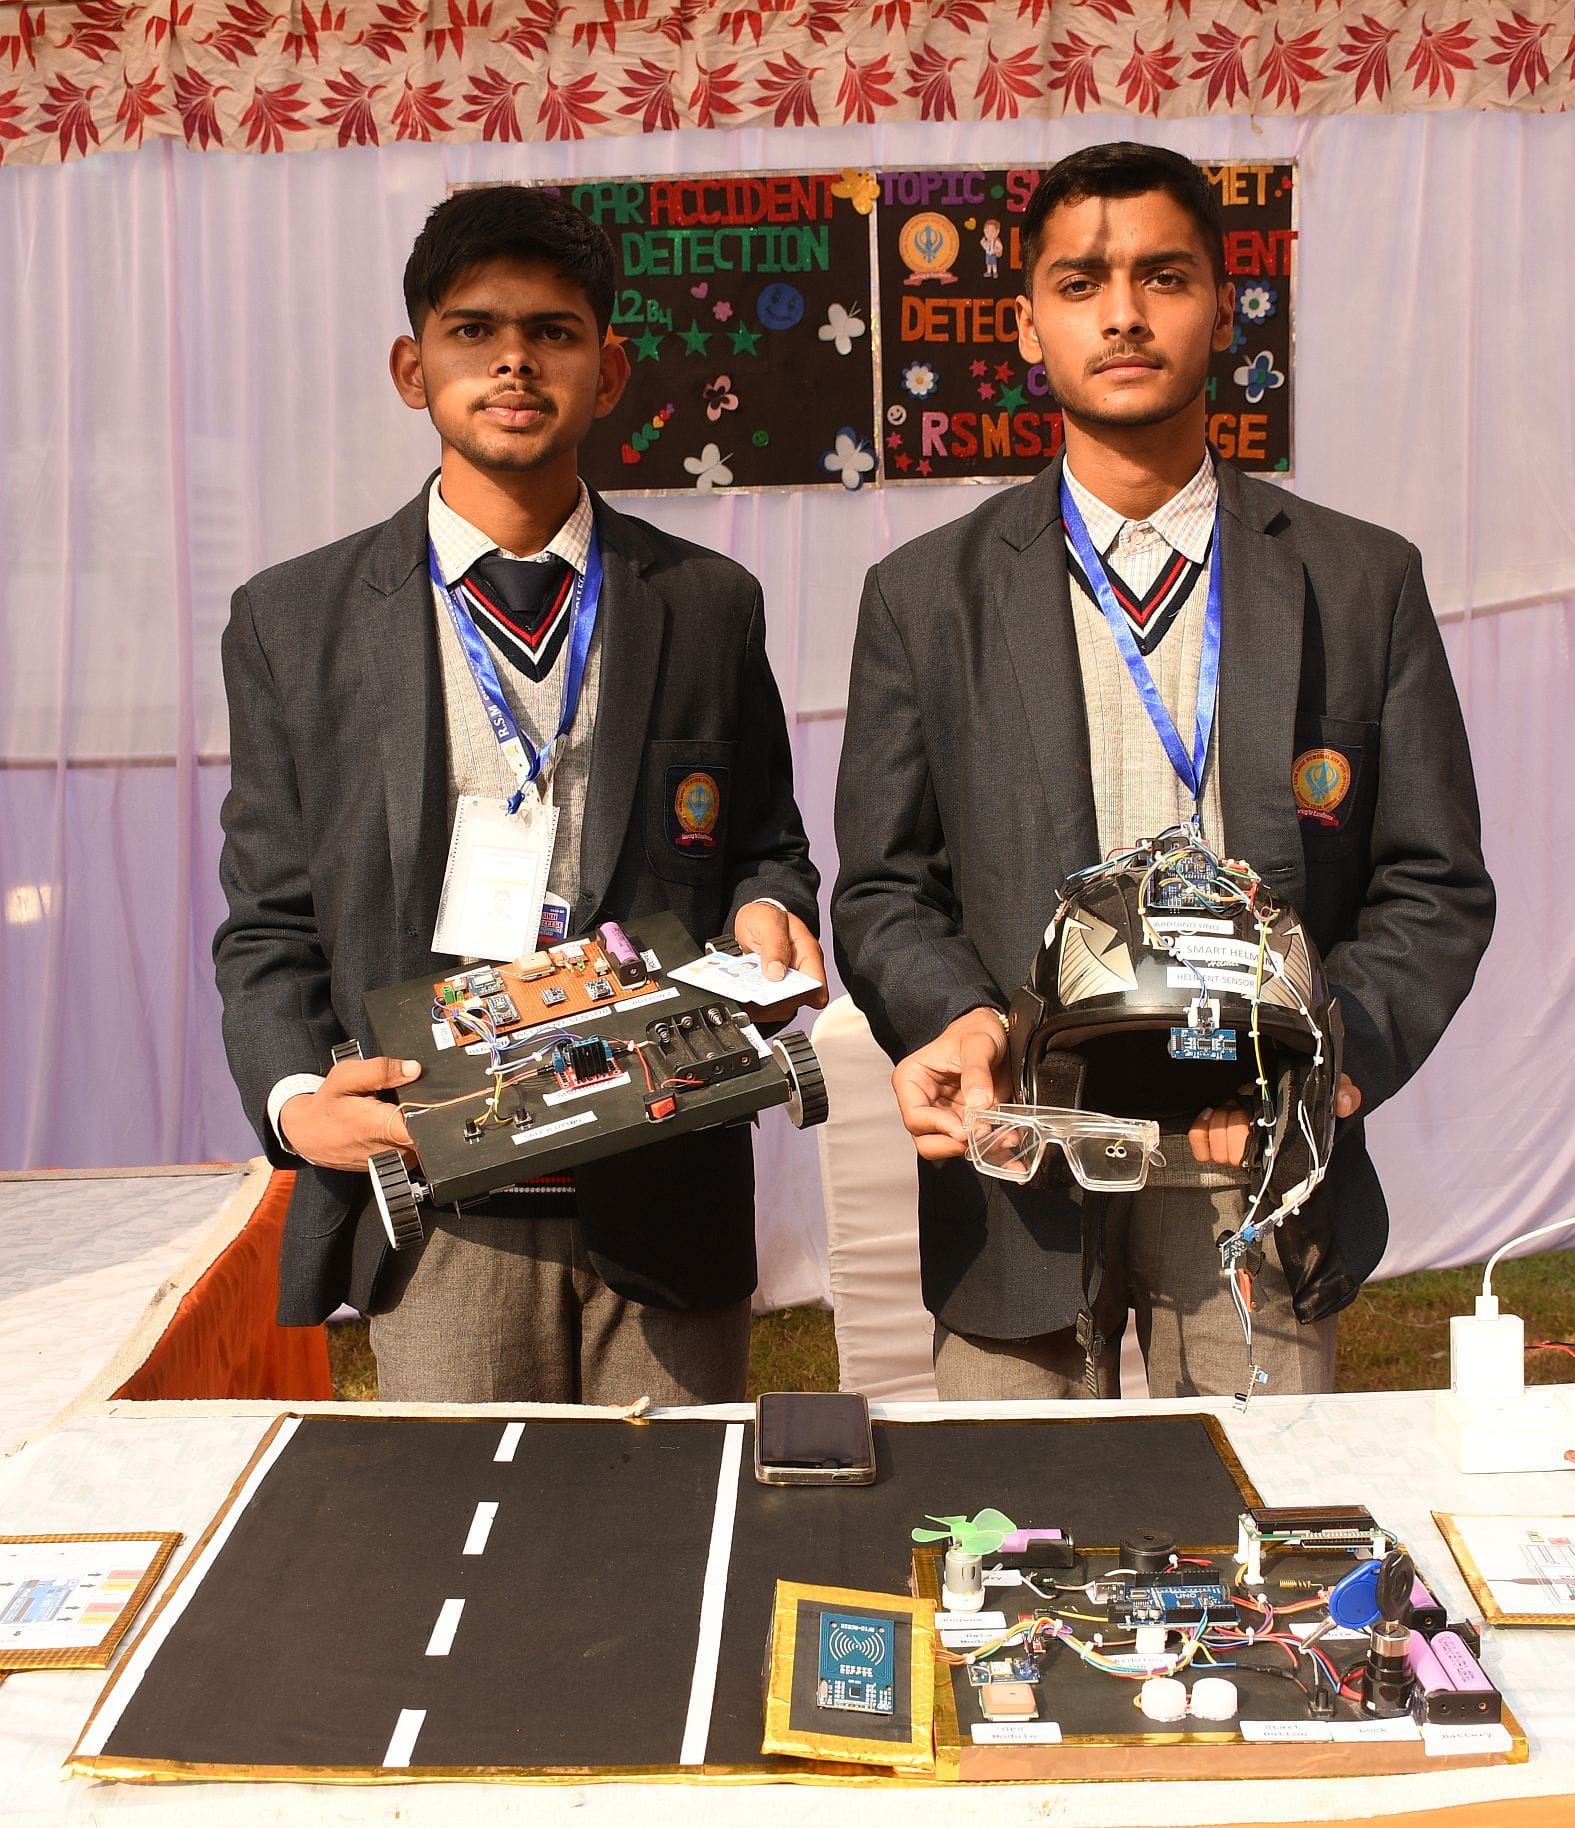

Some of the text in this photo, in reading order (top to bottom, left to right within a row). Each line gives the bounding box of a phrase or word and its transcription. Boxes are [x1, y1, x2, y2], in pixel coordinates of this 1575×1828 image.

[572, 174, 839, 226] CAR ACCIDENT
[877, 170, 986, 207] TOPIC
[1203, 165, 1274, 207] MET
[622, 226, 830, 276] DETECTION
[901, 296, 1018, 343] DETEC
[1186, 945, 1227, 956] SMART
[1221, 975, 1255, 988] SENSOR
